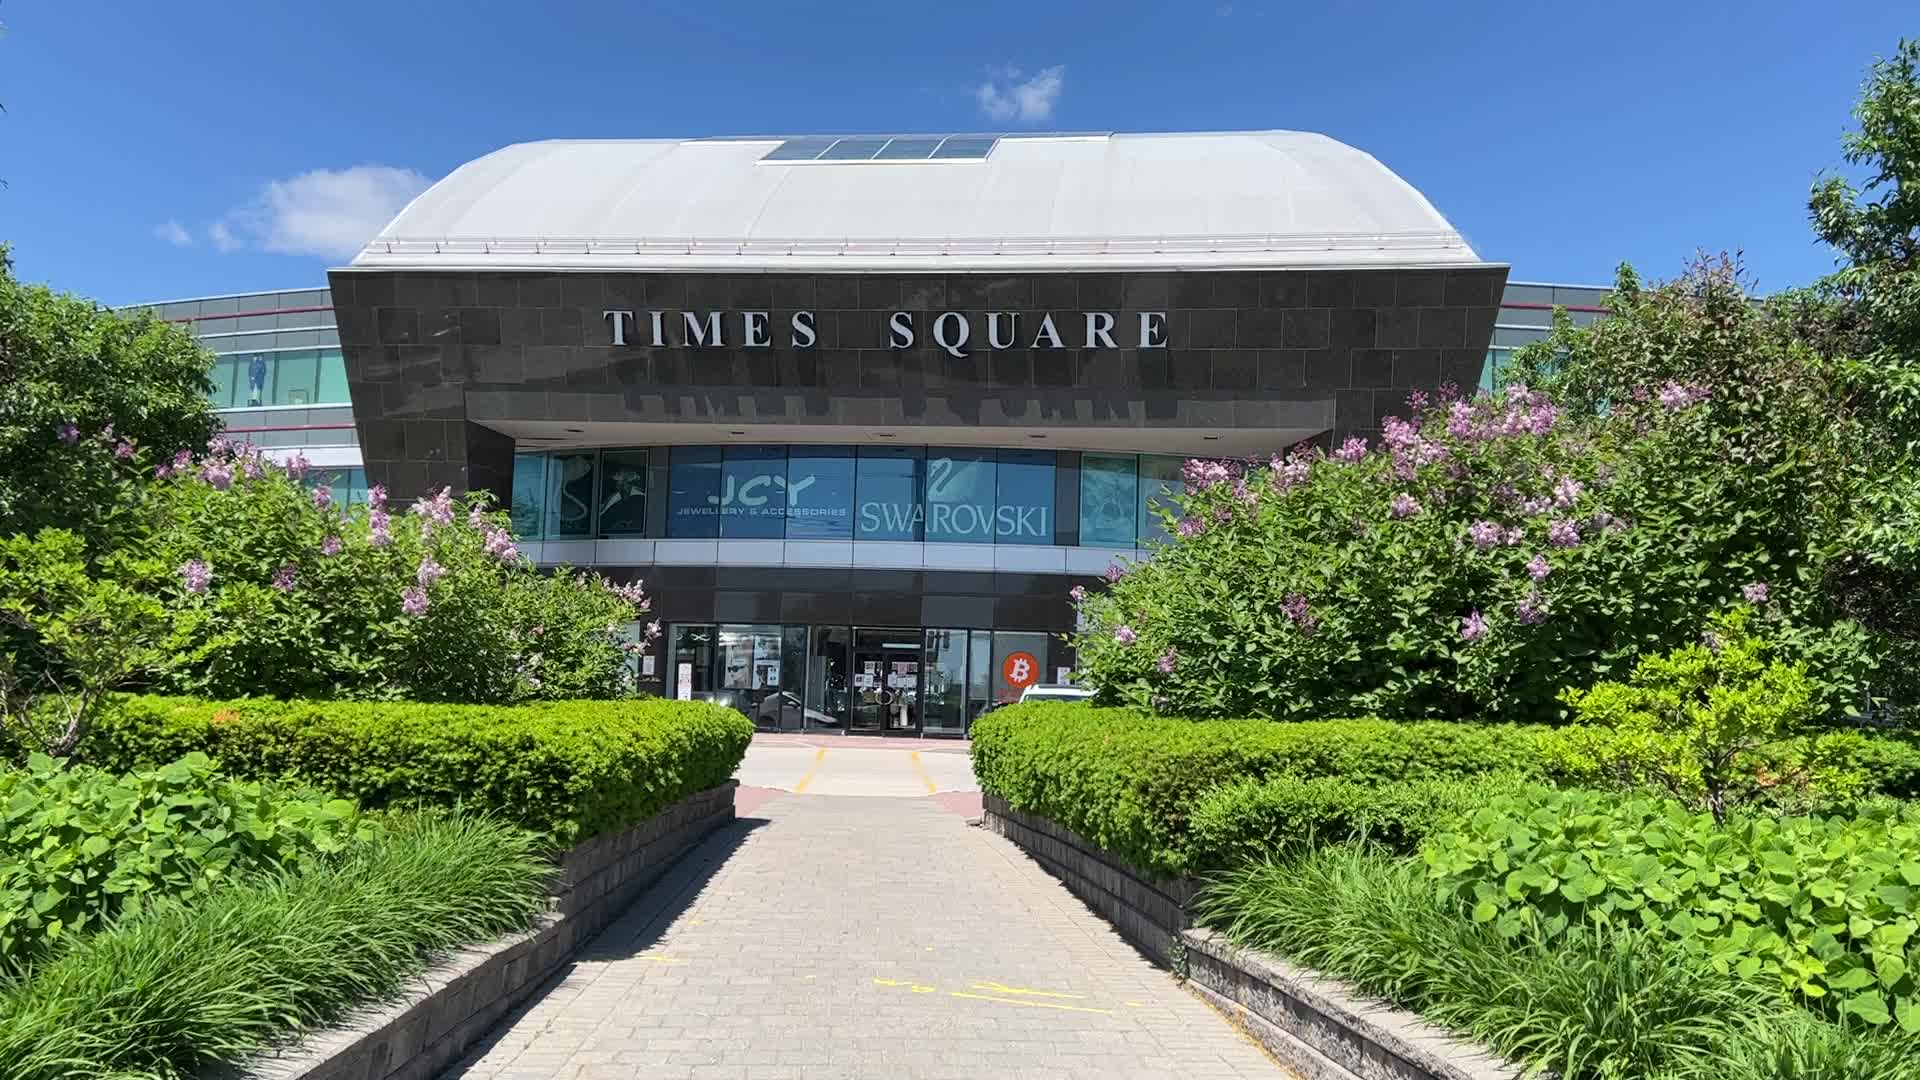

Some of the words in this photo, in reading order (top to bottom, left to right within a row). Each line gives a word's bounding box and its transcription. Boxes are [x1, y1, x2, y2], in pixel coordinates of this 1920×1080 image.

[603, 310, 817, 347] TIMES
[888, 310, 1169, 357] SQUARE
[707, 474, 816, 506] JCY
[676, 507, 745, 516] JEWELLERY
[861, 501, 1048, 537] SWAROVSKI
